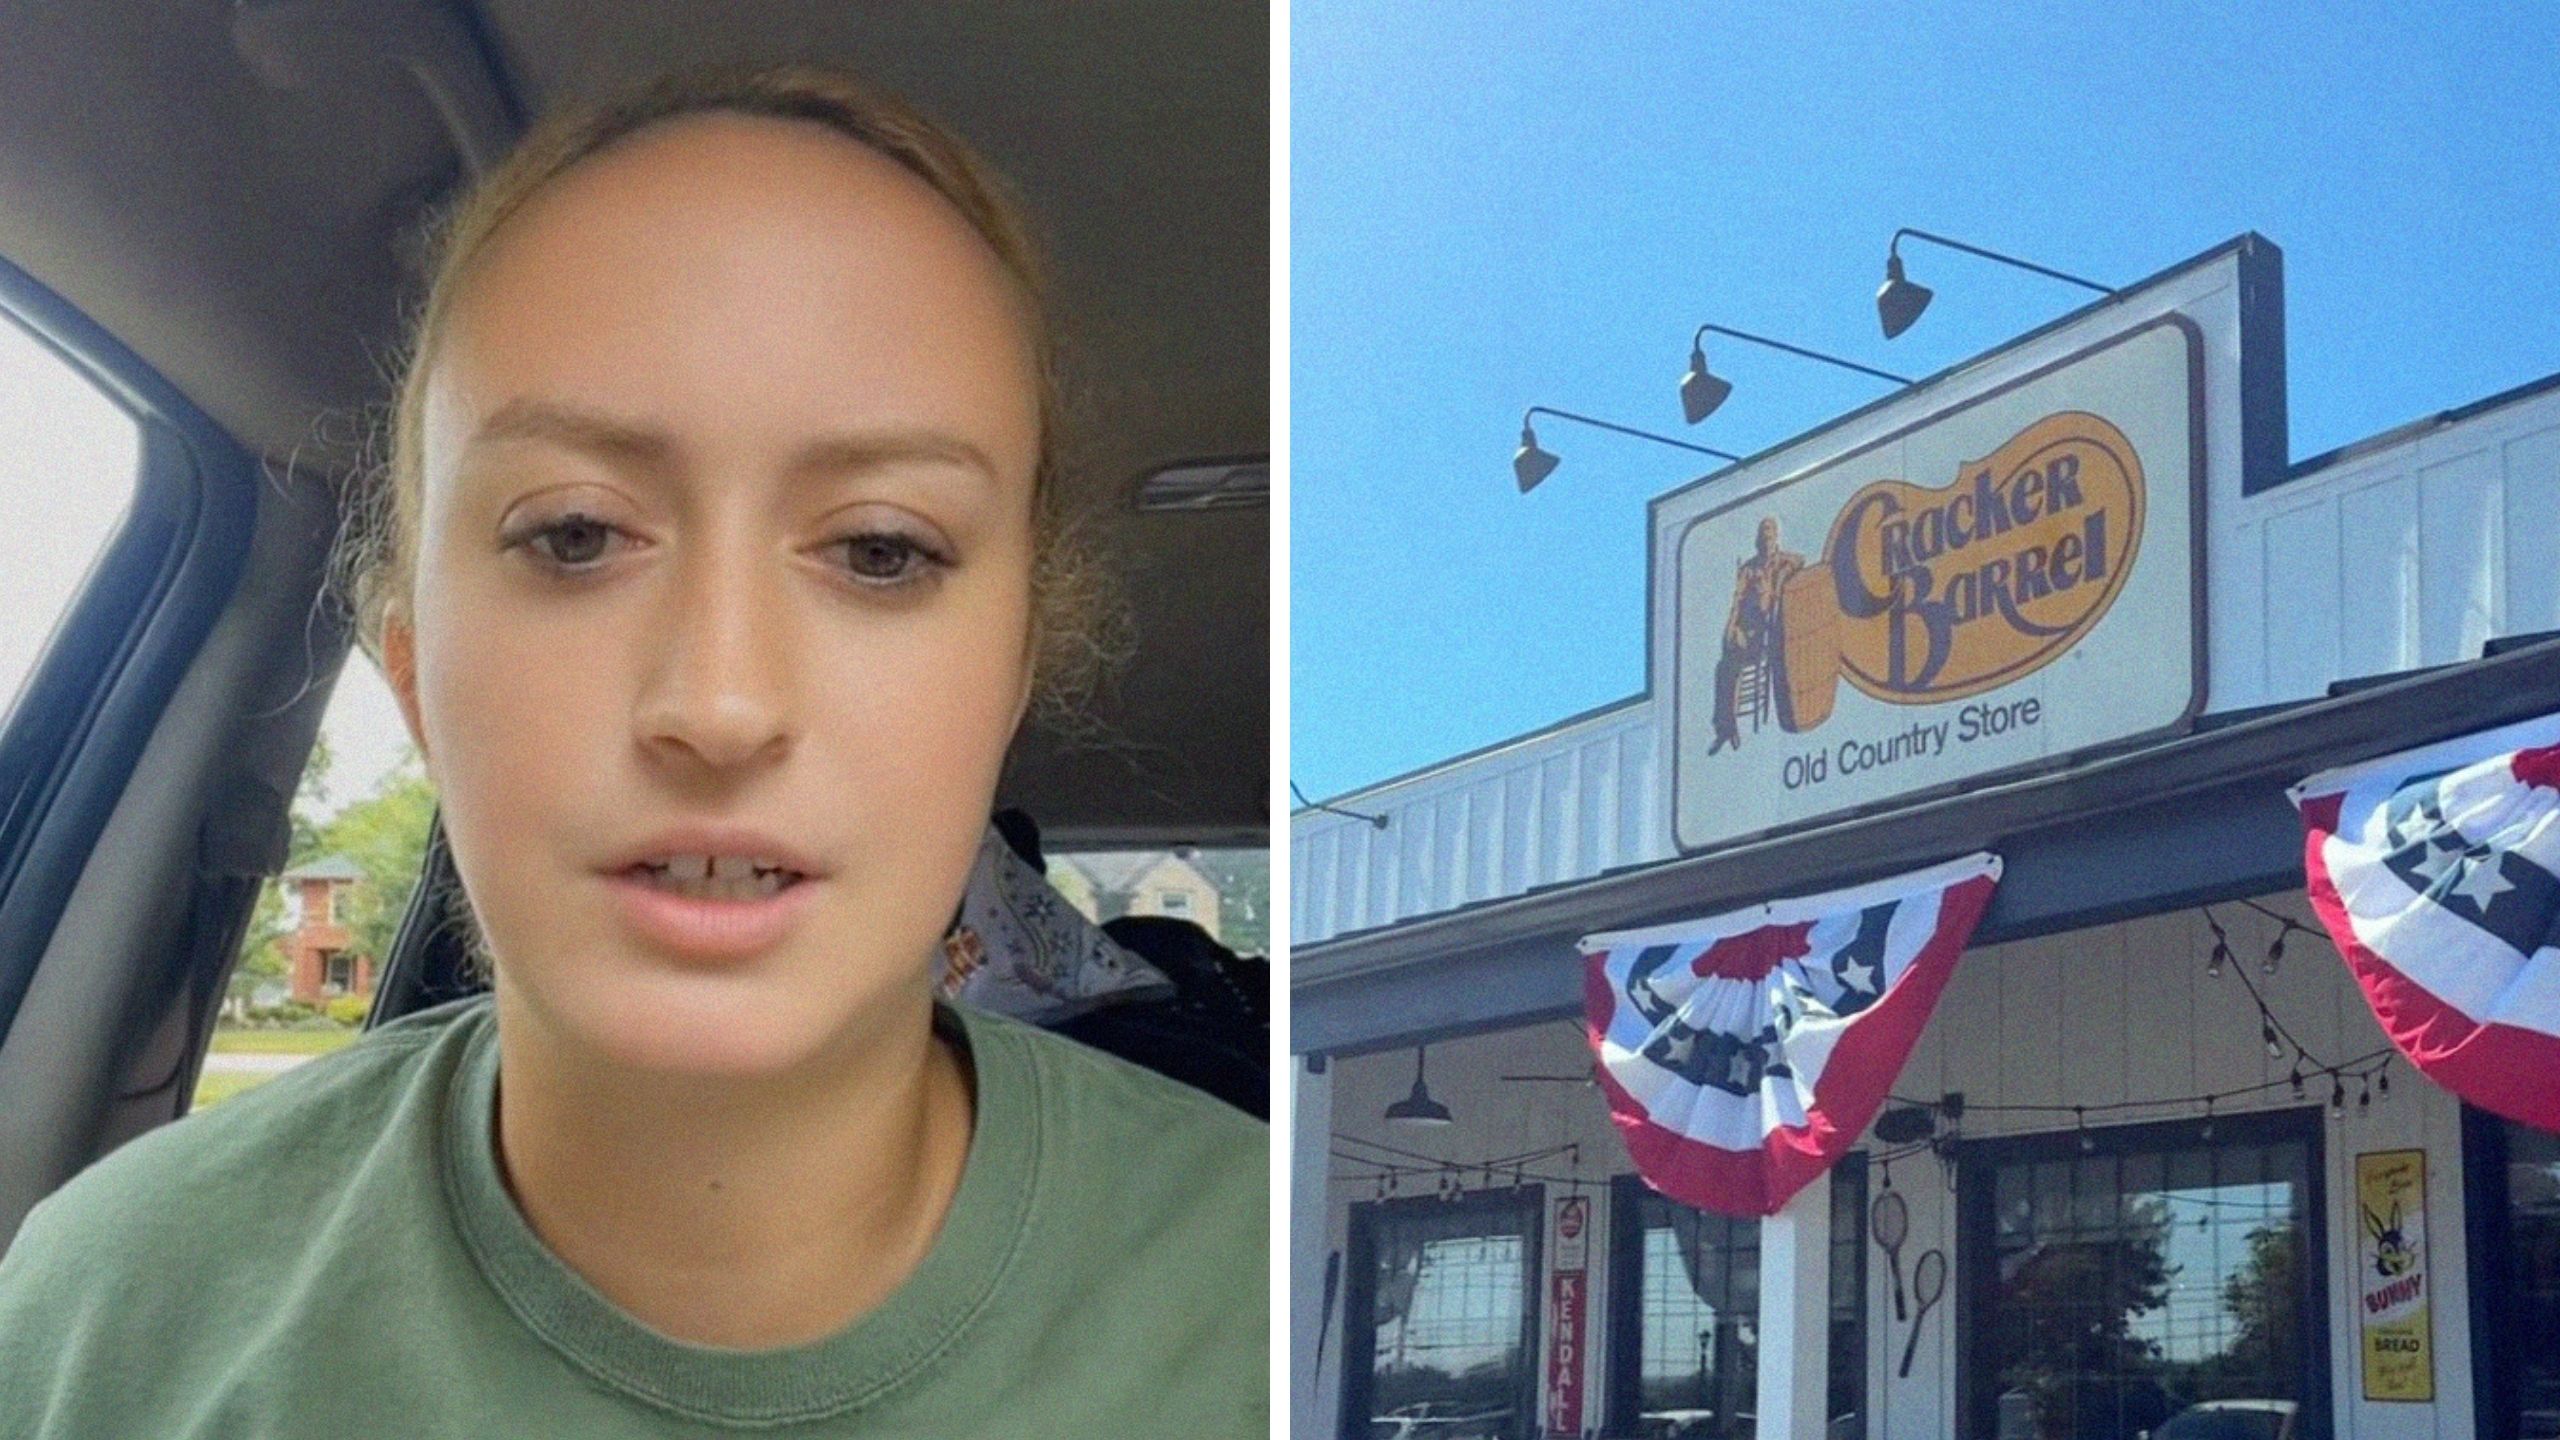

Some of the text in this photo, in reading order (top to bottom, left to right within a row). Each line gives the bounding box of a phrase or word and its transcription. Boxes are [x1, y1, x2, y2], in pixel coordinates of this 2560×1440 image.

[1783, 696, 2042, 790] Old Country Store
[2366, 1273, 2423, 1313] BUNNY
[1556, 1280, 1576, 1432] KENDALL
[2375, 1337, 2421, 1353] BREAD
